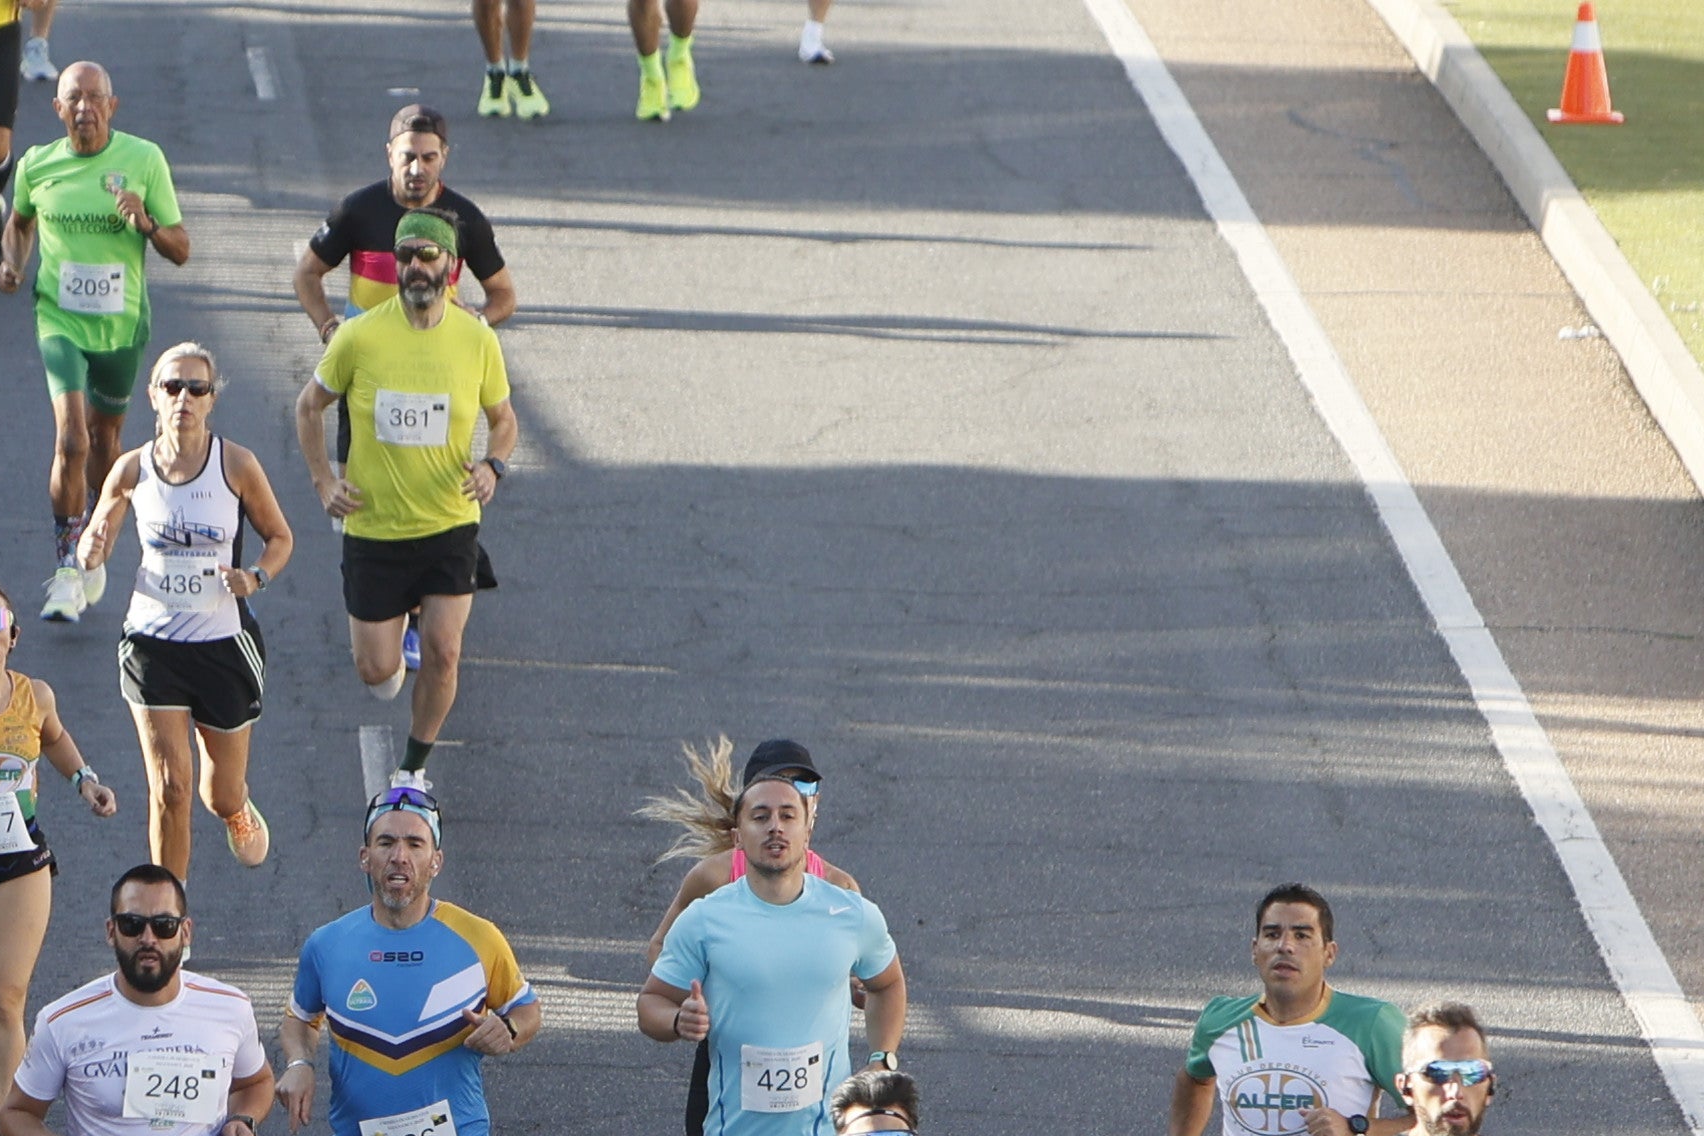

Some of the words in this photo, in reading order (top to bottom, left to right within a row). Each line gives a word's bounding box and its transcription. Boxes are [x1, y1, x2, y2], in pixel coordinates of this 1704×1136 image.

[70, 276, 111, 297] 209
[389, 407, 429, 428] 361
[159, 573, 203, 595] 436
[145, 1073, 200, 1101] 248
[756, 1066, 809, 1093] 428
[1235, 1092, 1315, 1111] ALCER
